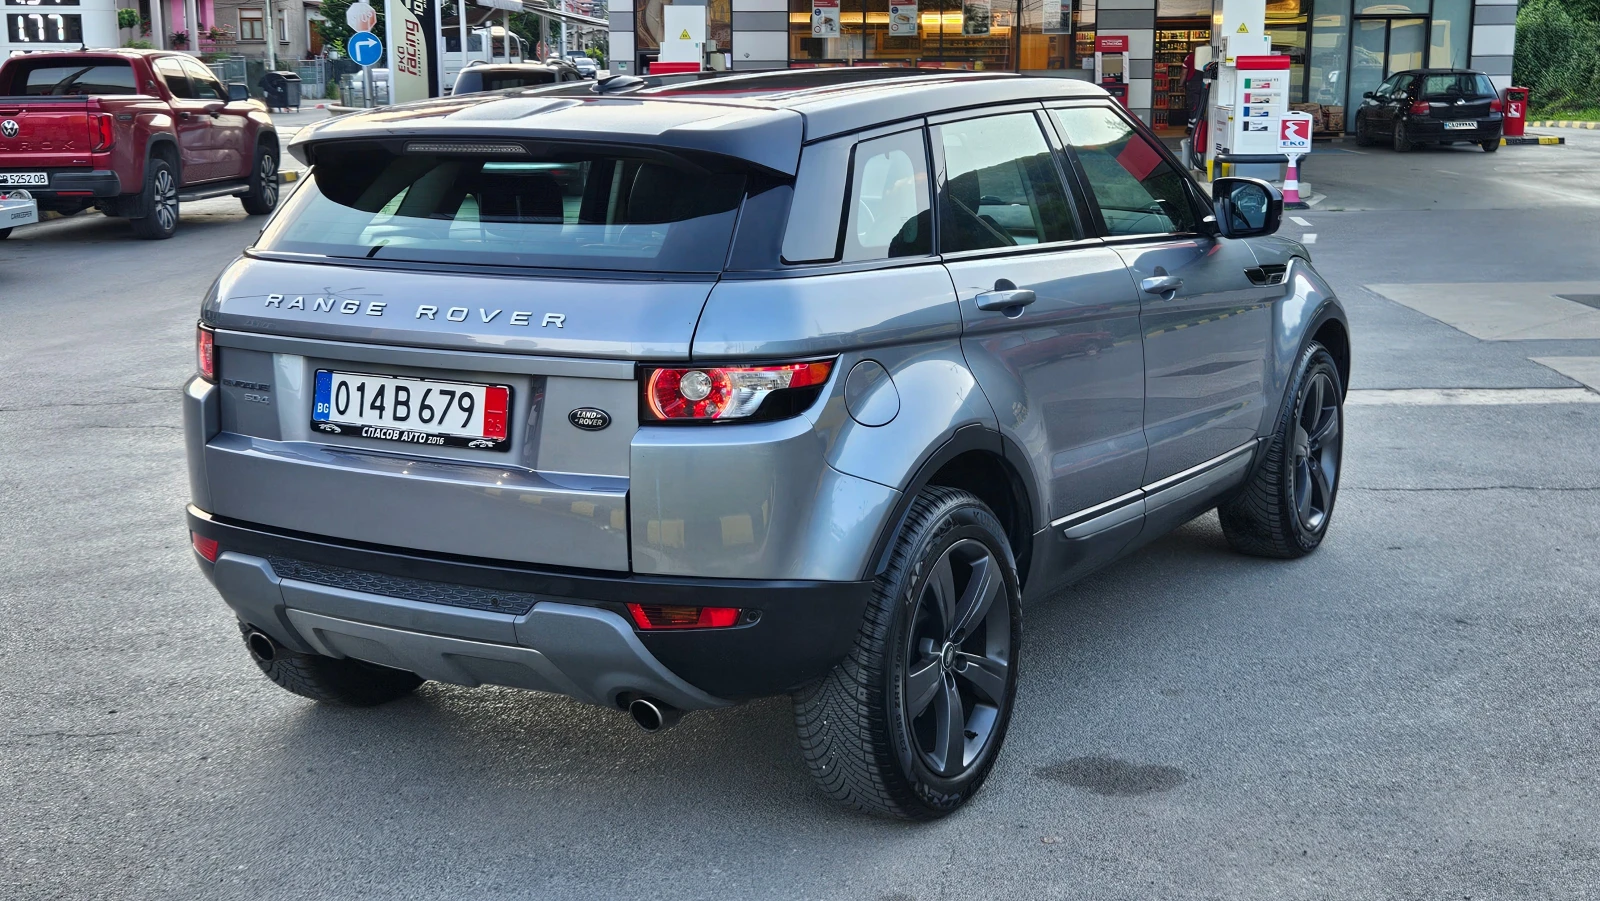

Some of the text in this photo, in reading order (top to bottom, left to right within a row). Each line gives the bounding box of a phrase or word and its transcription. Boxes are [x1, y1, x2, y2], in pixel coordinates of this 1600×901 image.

[404, 19, 420, 77] racing
[397, 46, 406, 73] EKO
[10, 174, 33, 184] 5252
[264, 293, 568, 328] RANGE ROVER
[244, 393, 270, 405] SD4
[317, 403, 329, 413] BG
[335, 380, 475, 428] 014B679
[576, 411, 597, 419] LAND
[578, 418, 603, 426] ROVER
[361, 426, 445, 445] СПАСОВ АУТО 2016
